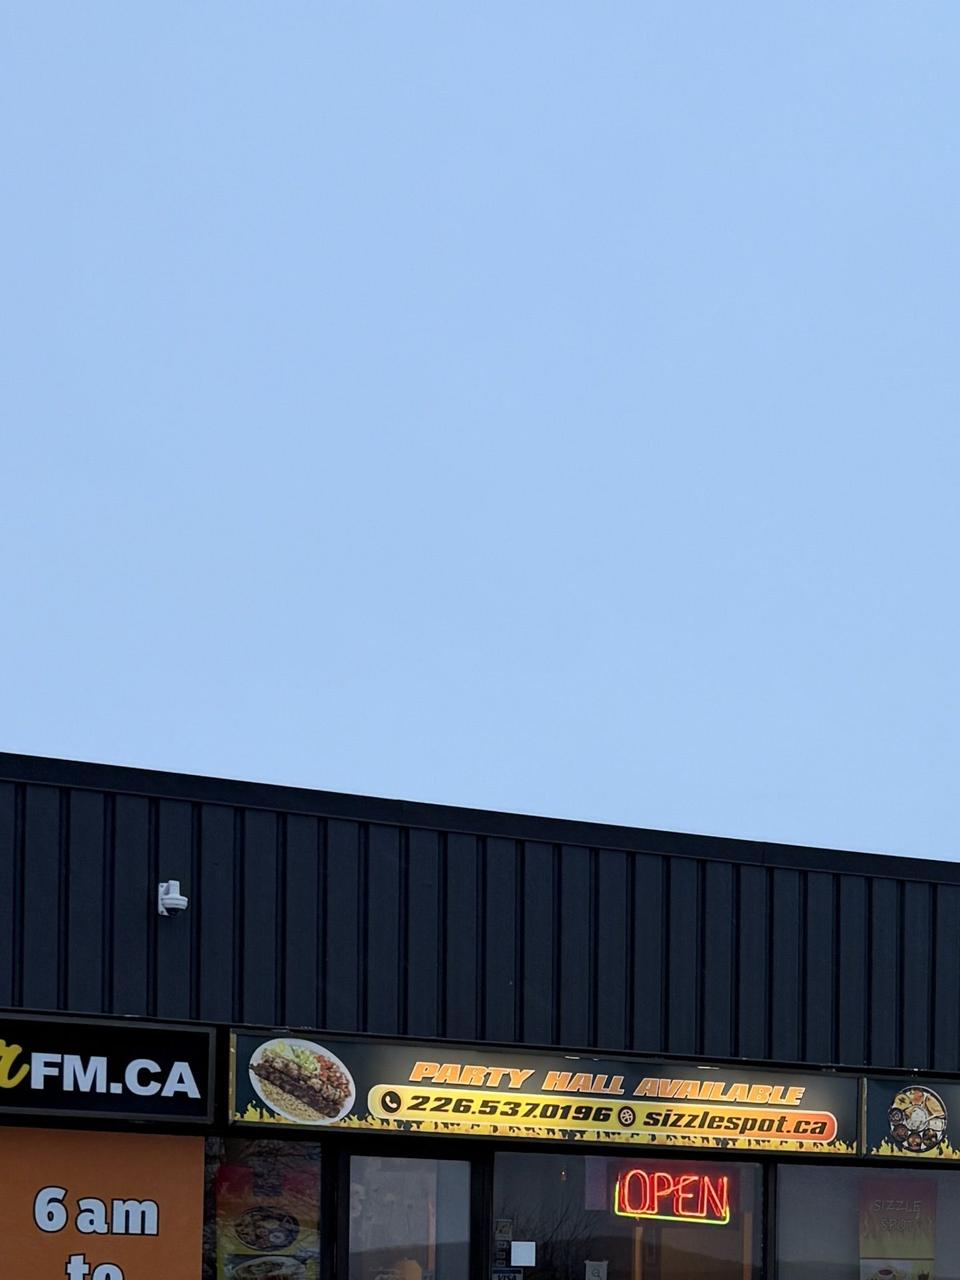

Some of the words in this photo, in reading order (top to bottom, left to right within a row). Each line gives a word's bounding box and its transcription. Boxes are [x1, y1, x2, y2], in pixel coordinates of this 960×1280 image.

[409, 1061, 535, 1089] PARTY
[541, 1071, 625, 1095] HALL
[633, 1078, 806, 1105] AVAILABLE
[407, 1095, 613, 1122] 226.537.0196
[643, 1109, 827, 1135] sizzlespot.ca
[34, 1185, 68, 1232] 6
[75, 1197, 159, 1236] am
[620, 1169, 728, 1217] OPEN
